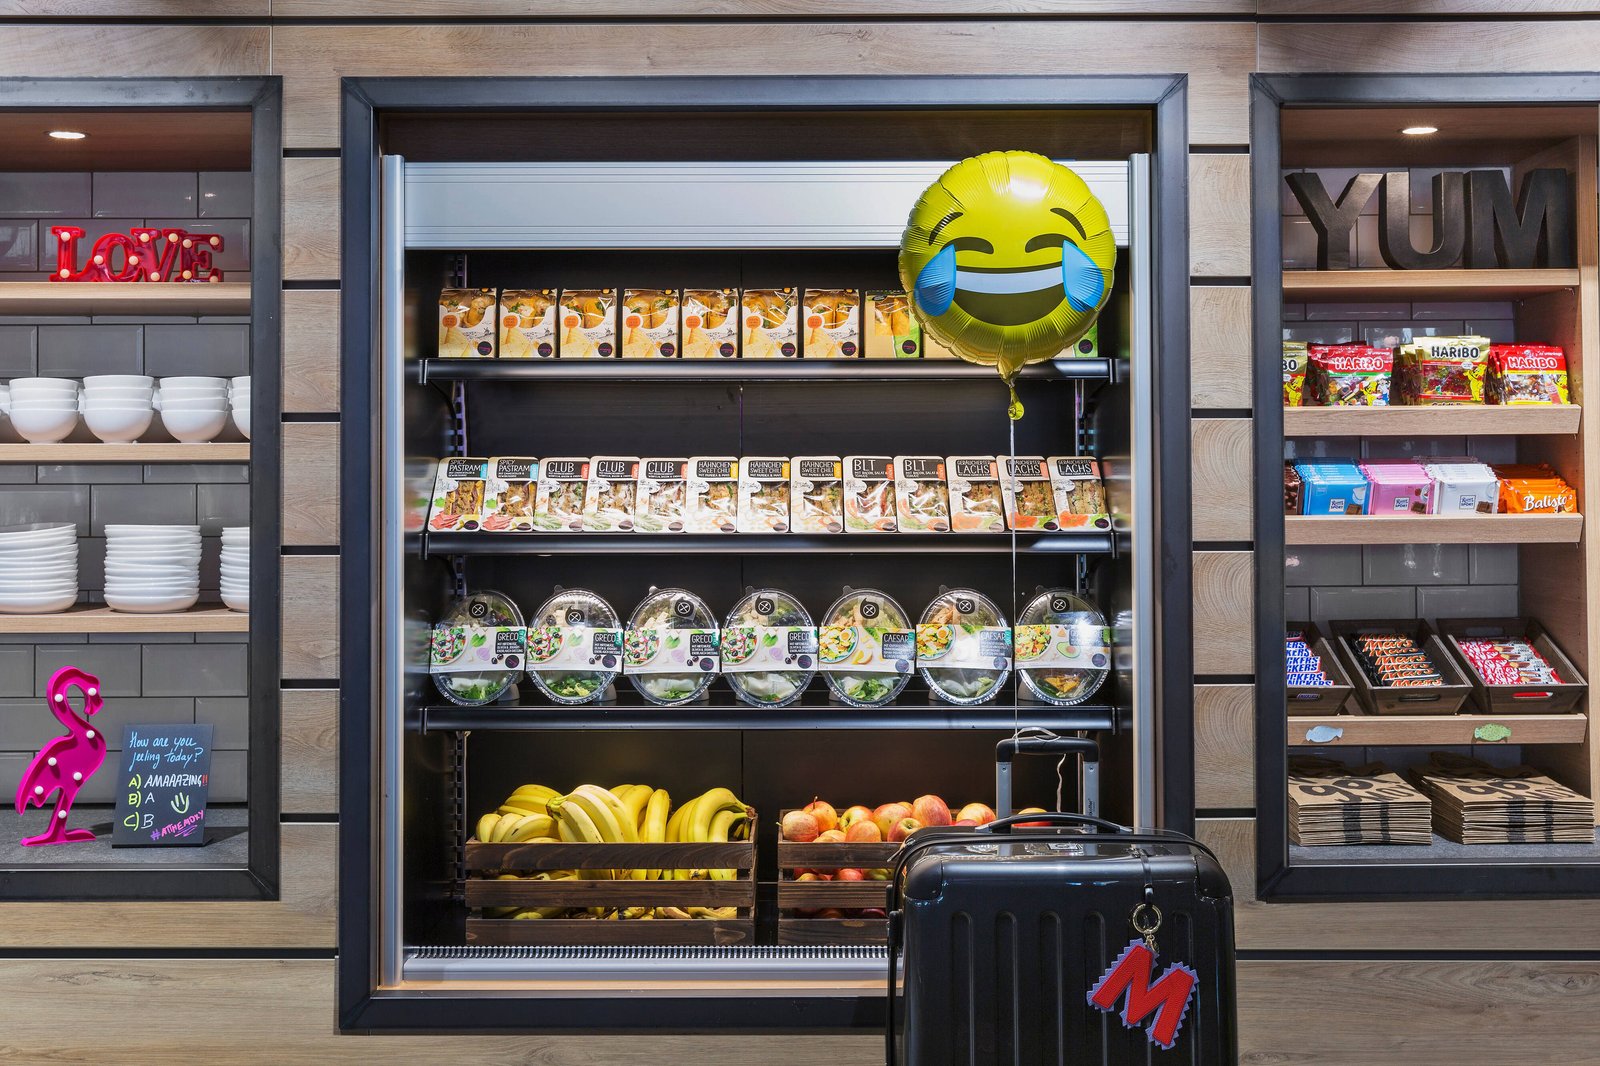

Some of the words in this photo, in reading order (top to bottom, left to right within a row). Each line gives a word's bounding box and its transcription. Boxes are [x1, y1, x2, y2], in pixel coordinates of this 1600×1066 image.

[1285, 168, 1575, 270] YUM
[50, 226, 224, 282] LOVE
[1431, 346, 1479, 358] HARIBO
[1508, 357, 1558, 368] HARIBO
[498, 465, 530, 473] PASTRAM
[548, 461, 575, 472] CLUB
[598, 461, 625, 472] CLUB
[648, 461, 674, 472] CLUB
[854, 459, 876, 471] BLT
[905, 459, 927, 471] BLT
[957, 465, 990, 474] LACHS
[1008, 465, 1041, 474] LACHS
[1059, 464, 1092, 473] LACHS
[1523, 494, 1567, 511] Balisto
[498, 633, 518, 641] GRECO
[595, 633, 616, 642] GRECO
[691, 635, 713, 643] GRECO
[790, 632, 811, 641] GRECO
[130, 731, 149, 748] How
[153, 738, 169, 747] are
[174, 737, 197, 751] you
[164, 747, 204, 769] today?
[128, 774, 141, 789] A)
[128, 791, 141, 808] B)
[145, 792, 155, 804] A
[124, 812, 139, 831] C)
[141, 814, 154, 829] B
[1090, 942, 1196, 1048] M
